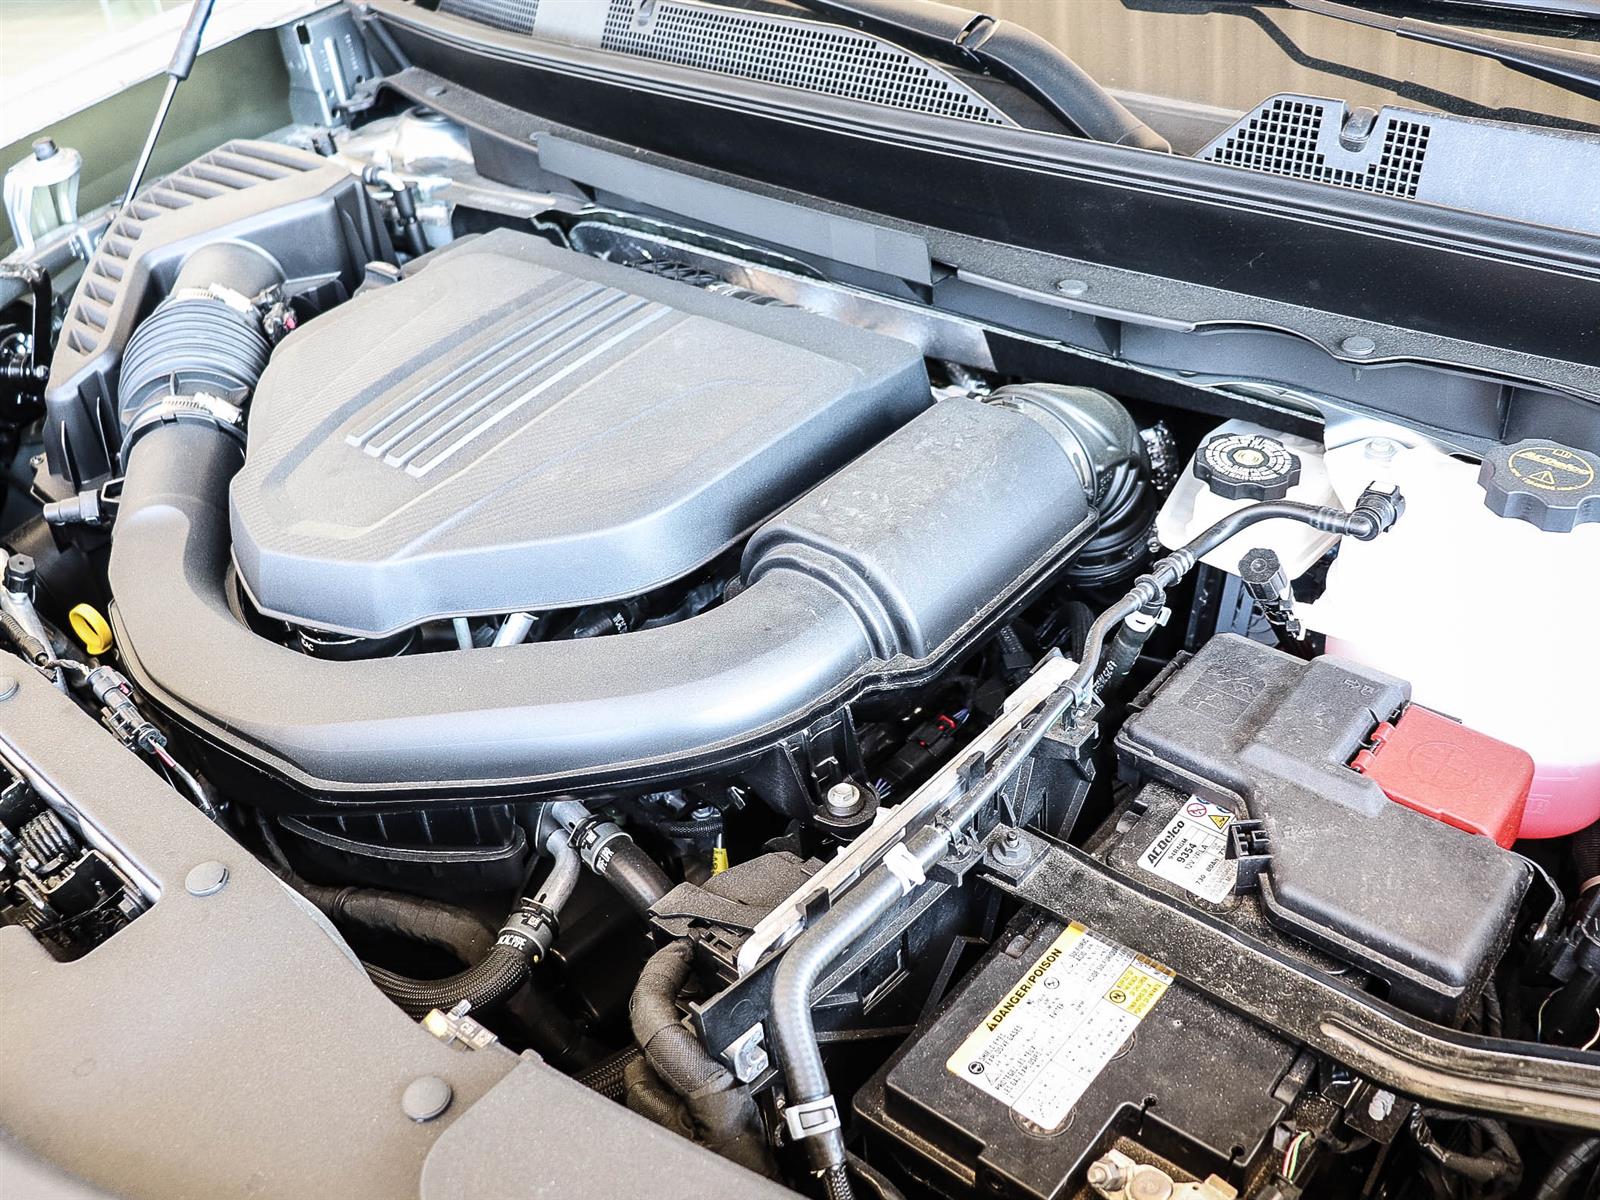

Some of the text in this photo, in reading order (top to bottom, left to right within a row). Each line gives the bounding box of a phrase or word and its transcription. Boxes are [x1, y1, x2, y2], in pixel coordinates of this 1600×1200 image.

[1147, 820, 1185, 863] ACDelco
[1176, 842, 1197, 863] 9354
[993, 948, 1062, 1022] DANGER/POISON
